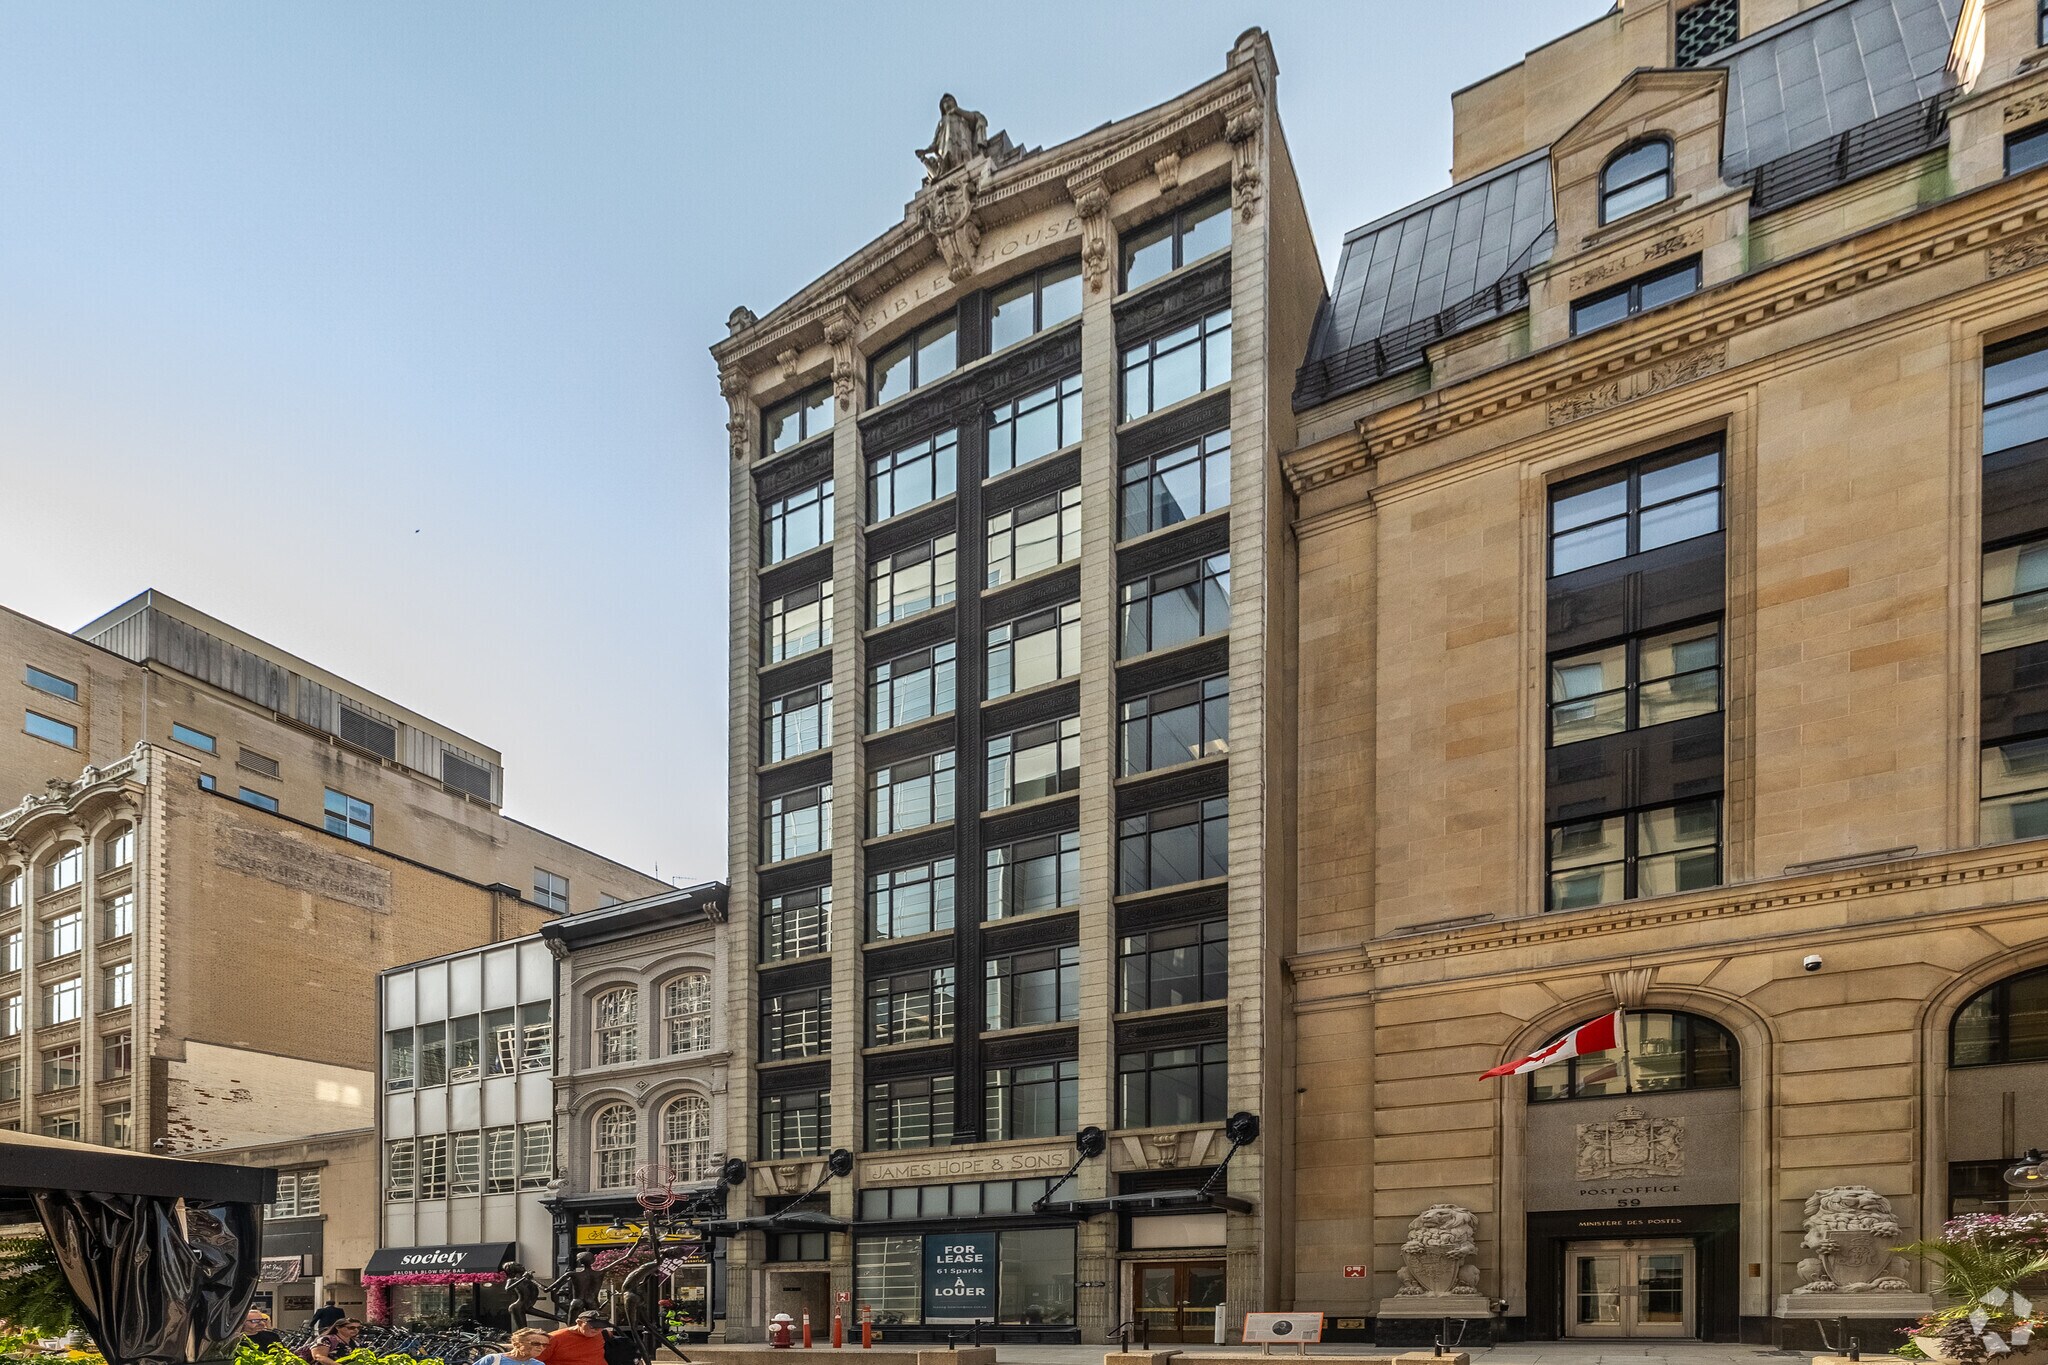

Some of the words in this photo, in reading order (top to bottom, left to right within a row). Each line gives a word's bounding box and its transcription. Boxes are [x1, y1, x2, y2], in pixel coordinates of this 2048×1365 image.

[862, 275, 946, 332] BIBLE
[981, 217, 1079, 267] HOUSE
[872, 1164, 931, 1179] JAMES
[938, 1159, 984, 1175] HOPE
[991, 1158, 1003, 1171] &
[1011, 1153, 1064, 1170] SONS
[1580, 1188, 1617, 1196] POST
[1622, 1185, 1681, 1194] OFFICE
[1617, 1198, 1641, 1207] 59
[944, 1245, 975, 1254] FOR
[400, 1249, 468, 1266] society
[937, 1254, 983, 1263] LEASE
[950, 1267, 983, 1275] Sparks
[954, 1276, 965, 1287] À
[935, 1287, 986, 1296] LOUER
